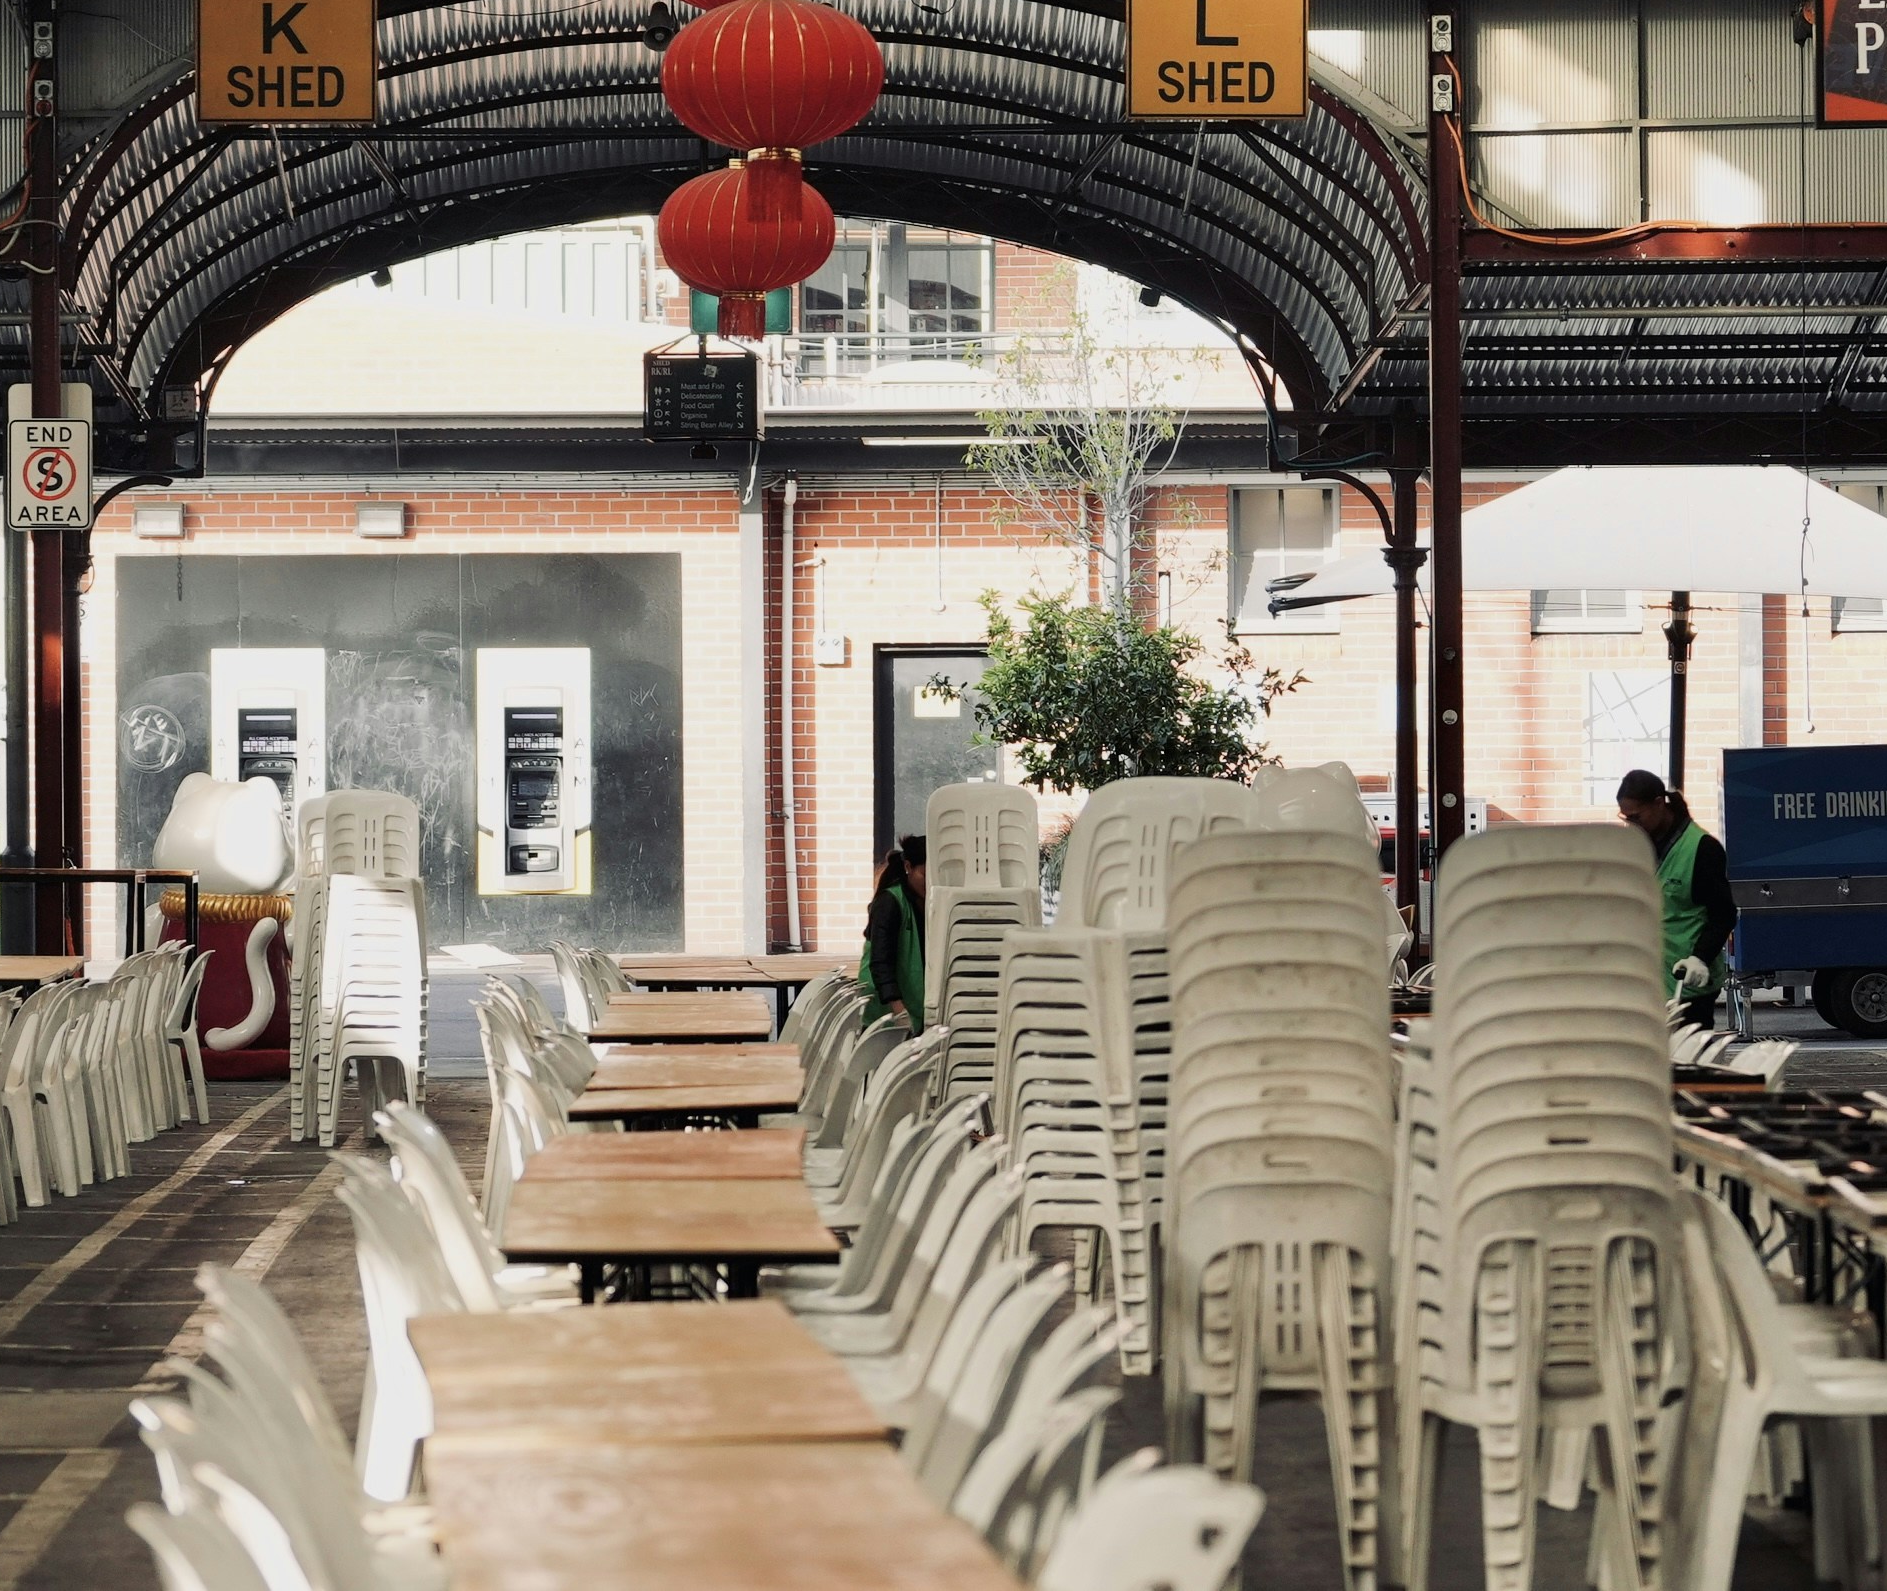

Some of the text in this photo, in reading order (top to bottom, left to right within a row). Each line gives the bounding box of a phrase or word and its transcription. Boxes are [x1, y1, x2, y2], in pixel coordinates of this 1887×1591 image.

[262, 2, 309, 54] K
[227, 65, 345, 108] SHED
[1157, 60, 1276, 103] SHED
[680, 412, 708, 420] Organics
[27, 427, 73, 444] END
[17, 505, 82, 523] AREA
[1773, 792, 1817, 819] FREE
